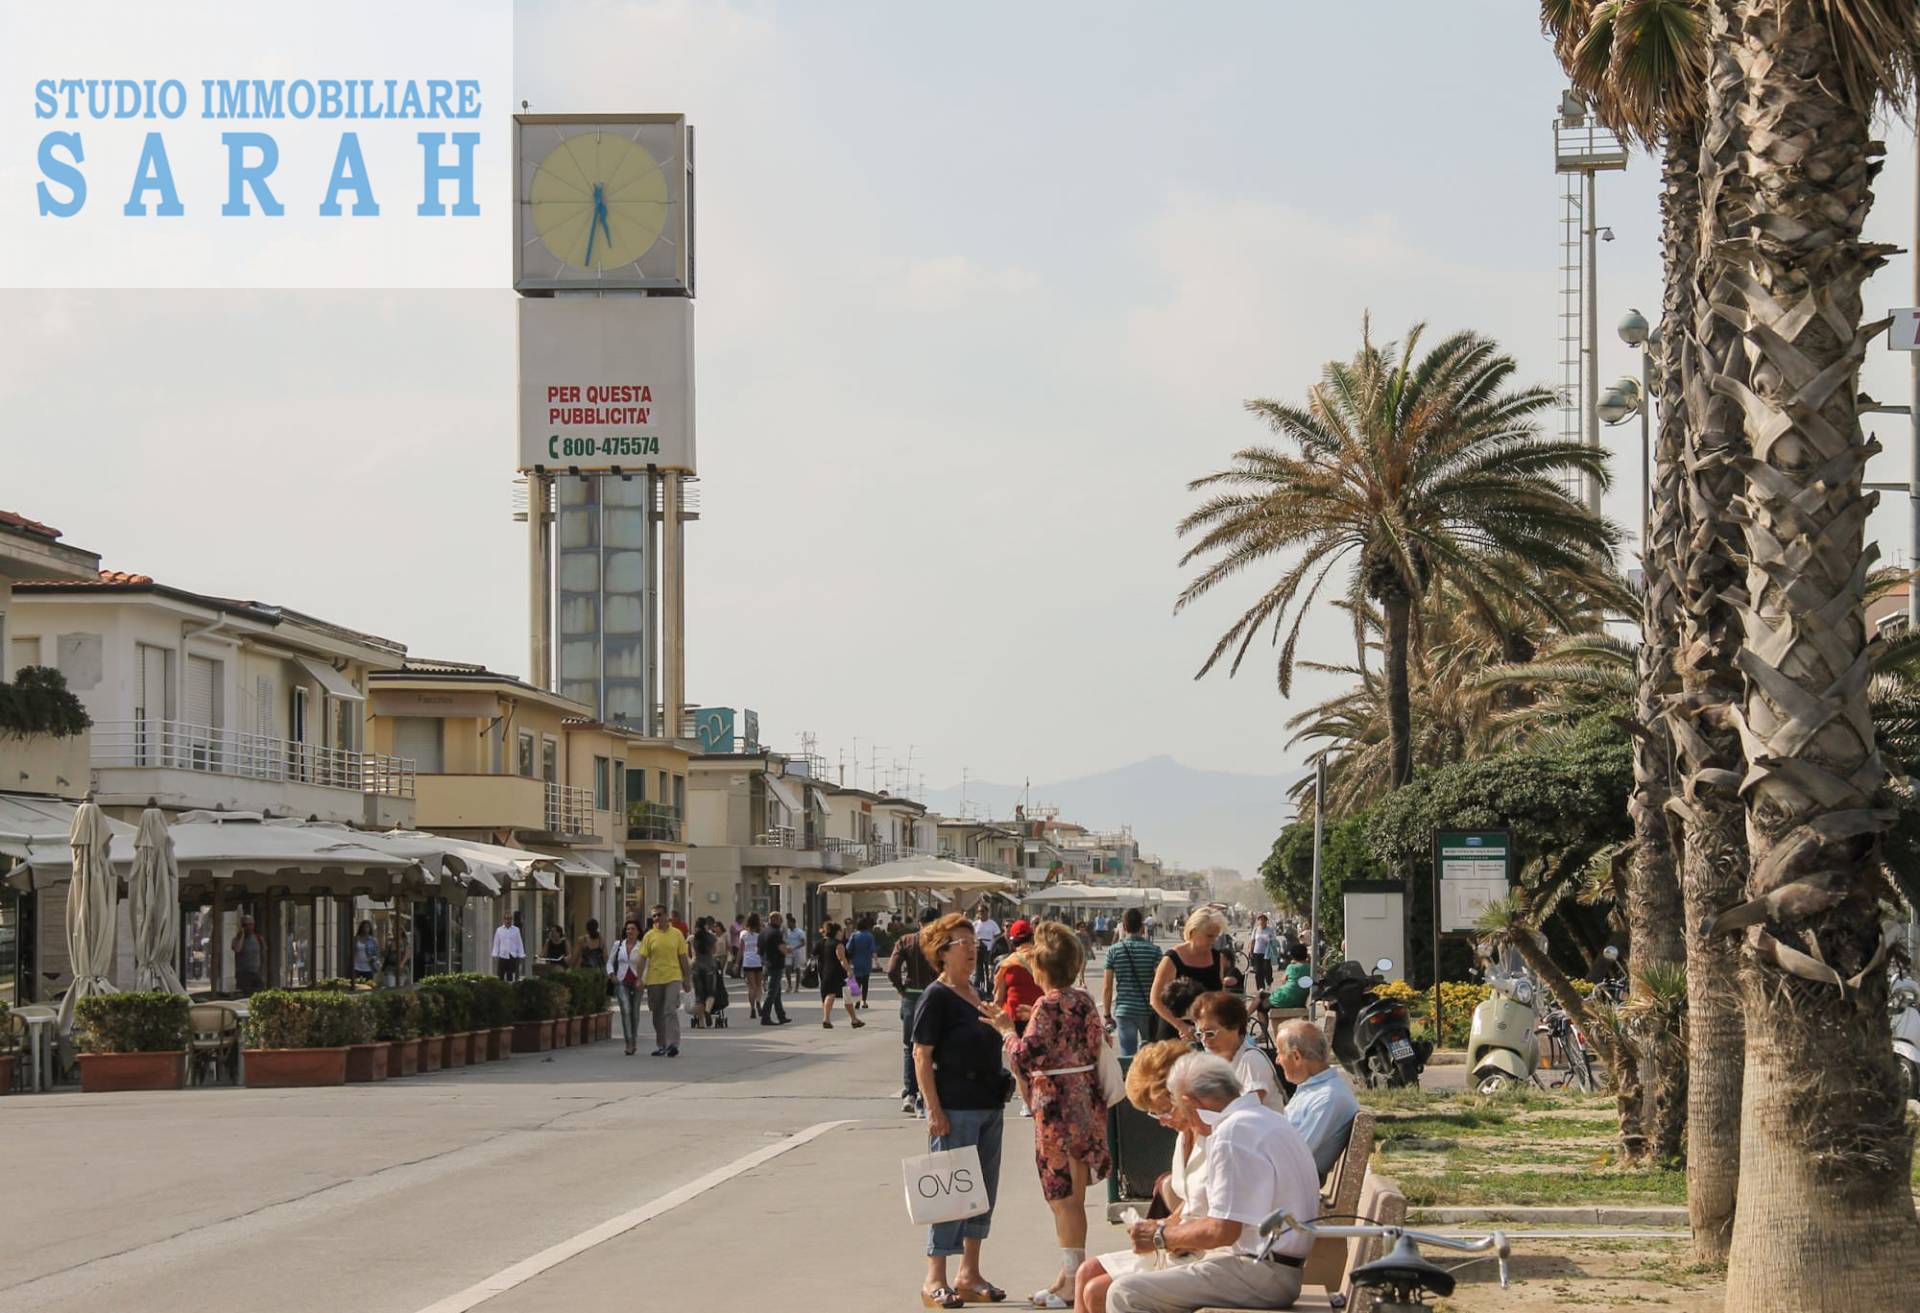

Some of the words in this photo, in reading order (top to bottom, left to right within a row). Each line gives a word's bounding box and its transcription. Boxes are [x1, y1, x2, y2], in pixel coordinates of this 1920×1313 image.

[547, 385, 581, 404] PER
[586, 385, 652, 405] QUESTA
[548, 407, 650, 425] PUBBLICITA'
[563, 437, 660, 457] 800-475574
[918, 1169, 974, 1198] OVS
